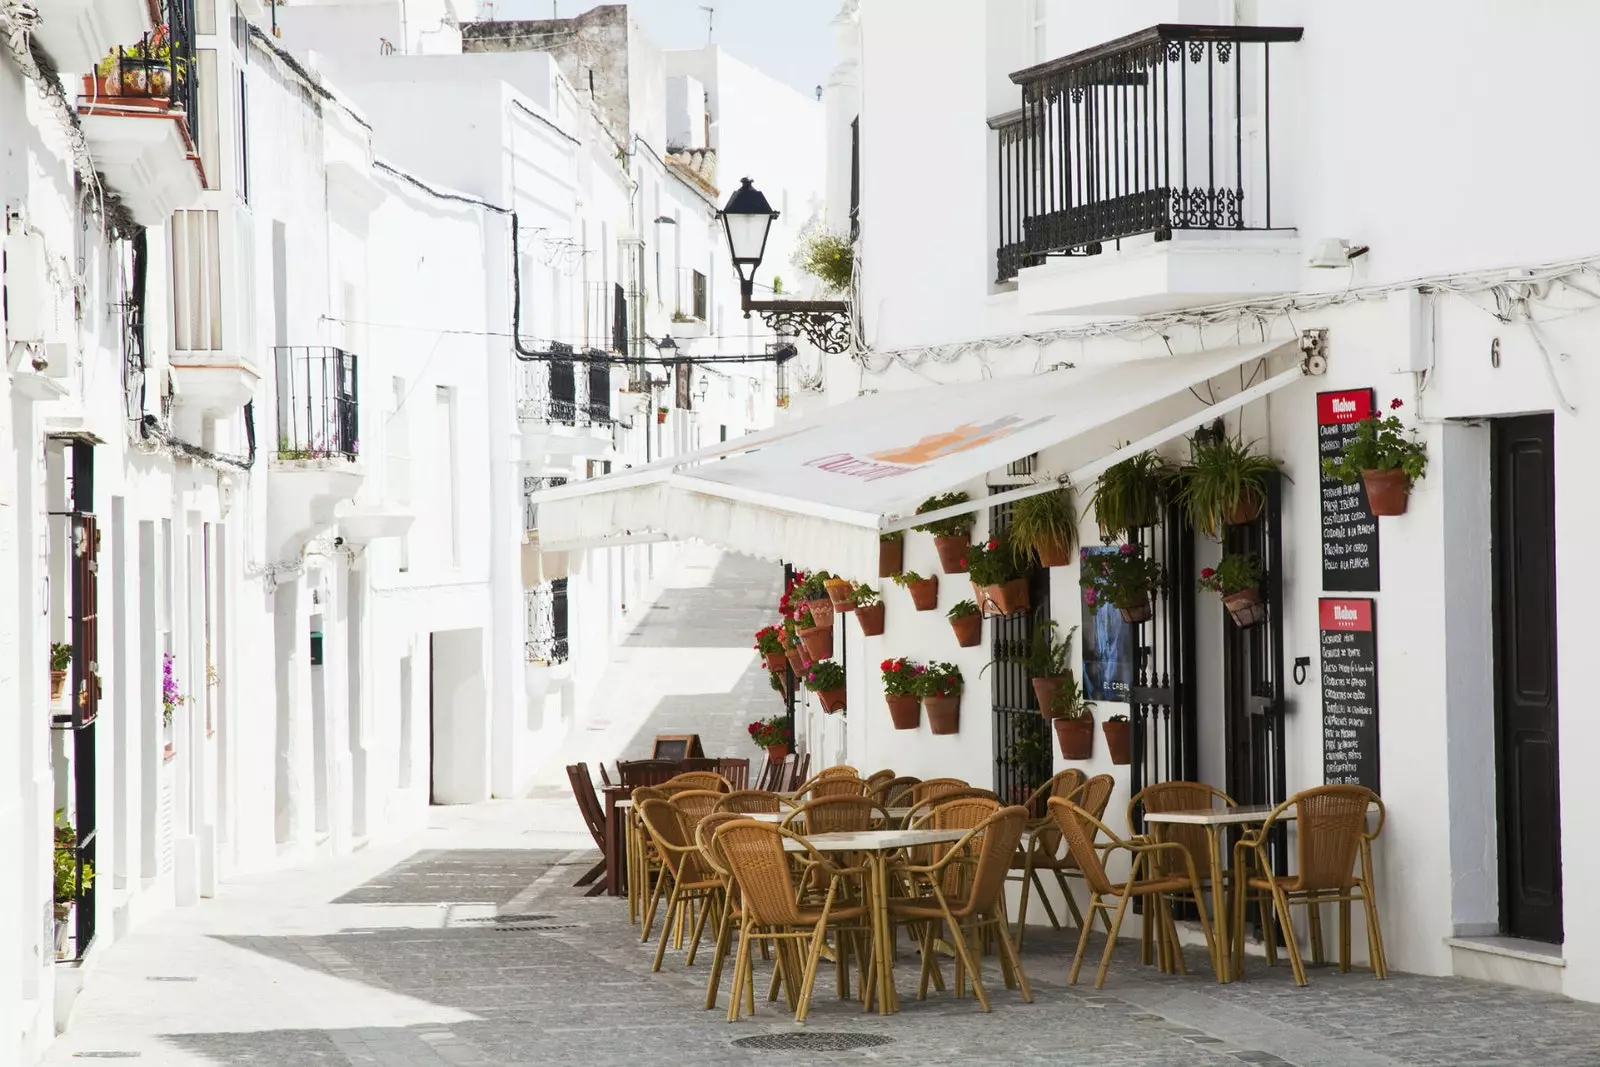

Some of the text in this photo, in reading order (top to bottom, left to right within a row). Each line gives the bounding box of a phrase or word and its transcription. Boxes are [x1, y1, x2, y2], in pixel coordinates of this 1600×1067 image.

[1491, 337, 1500, 369] 6
[1332, 397, 1356, 413] Mahou
[1334, 604, 1358, 620] Mahou
